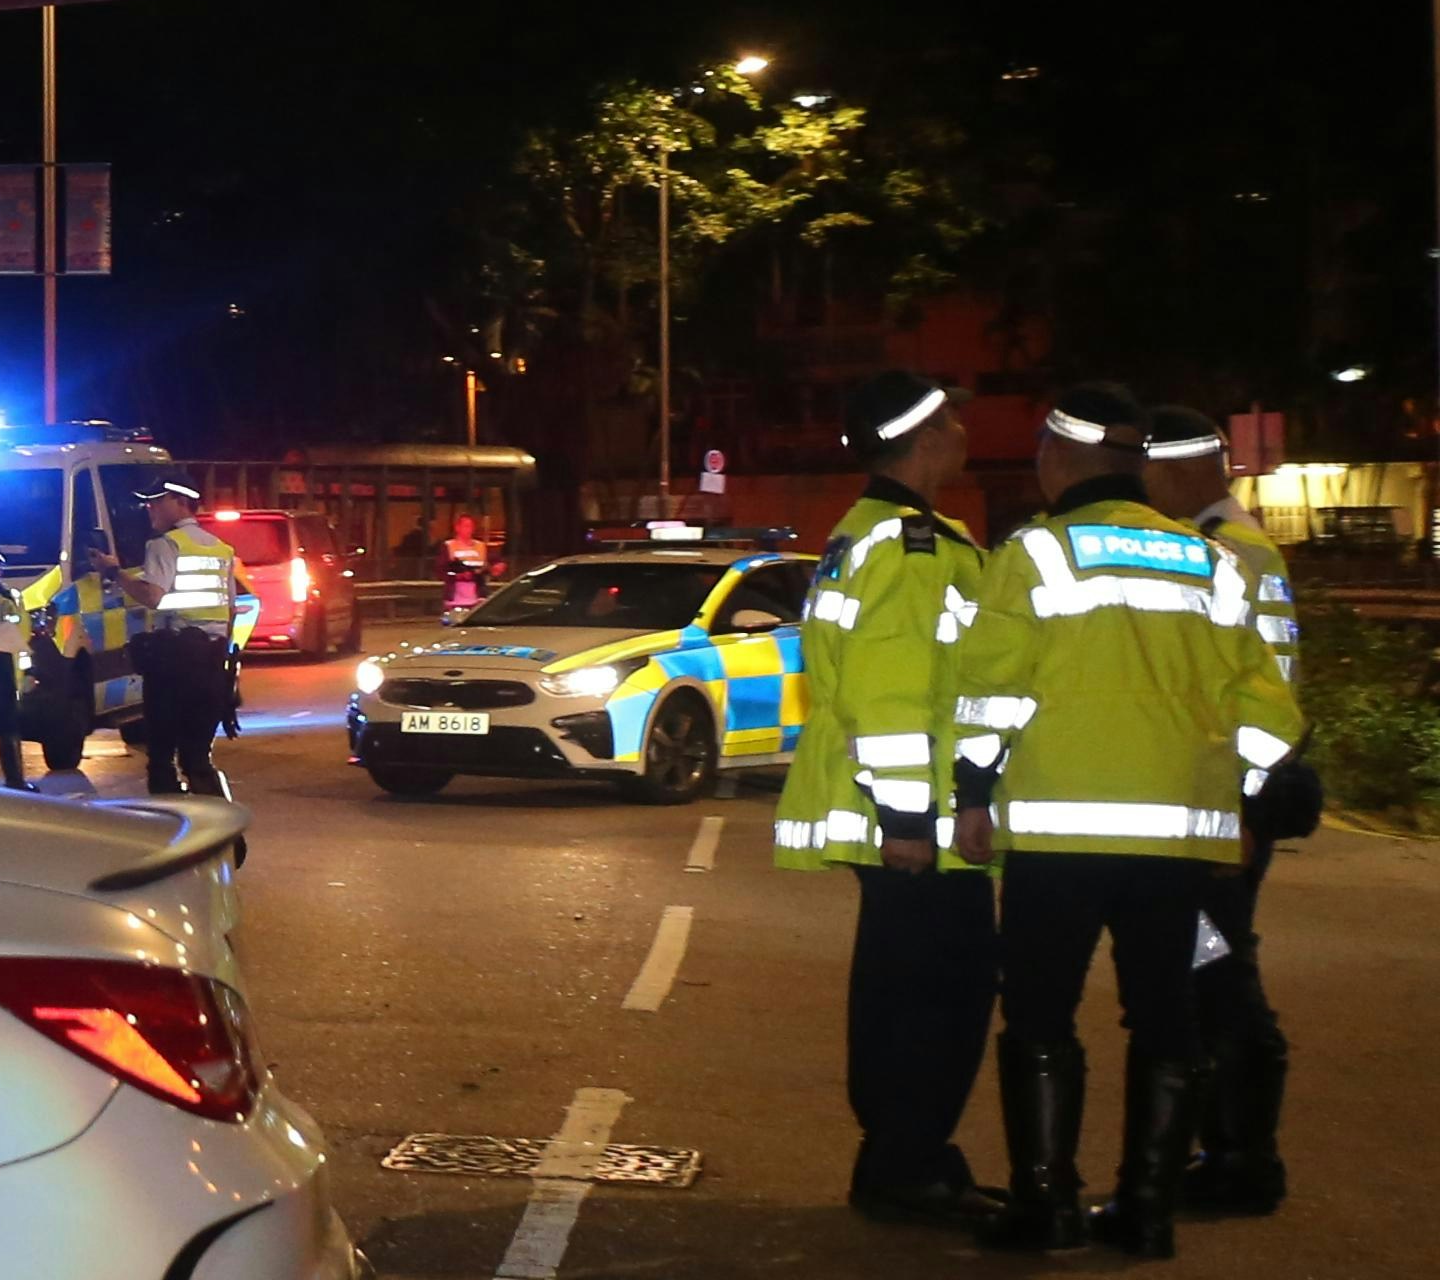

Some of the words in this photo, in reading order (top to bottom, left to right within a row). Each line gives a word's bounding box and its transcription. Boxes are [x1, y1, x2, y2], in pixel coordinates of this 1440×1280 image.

[1104, 535, 1185, 561] POLICE
[408, 715, 430, 730] AM
[438, 715, 481, 731] 8618
